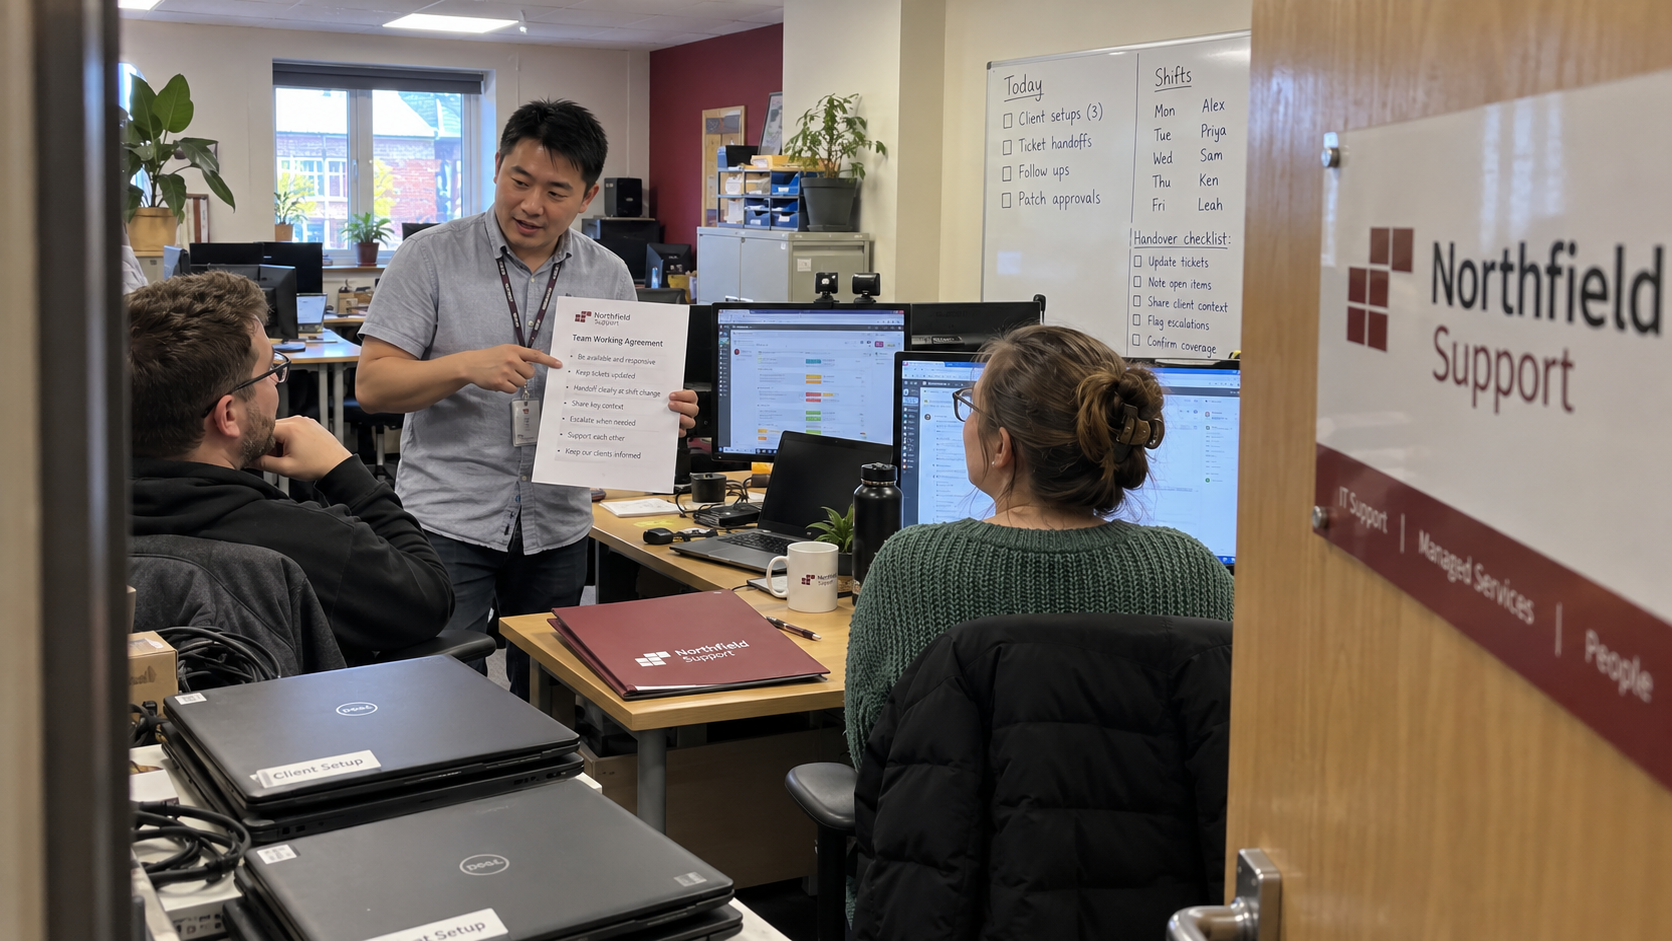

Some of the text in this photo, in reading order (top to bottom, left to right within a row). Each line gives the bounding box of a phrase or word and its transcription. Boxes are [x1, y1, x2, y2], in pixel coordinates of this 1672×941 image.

[1155, 65, 1192, 87] Shifts
[1004, 73, 1044, 102] Today
[1018, 102, 1104, 126] Client setups (3)
[1154, 98, 1225, 118] Mon Alex
[1154, 123, 1227, 143] Tue Priya
[1018, 133, 1093, 152] Ticket handoffs
[1153, 148, 1223, 165] Wed Sam
[1019, 163, 1070, 182] Follow ups
[1152, 173, 1219, 188] Thu Ken
[1018, 189, 1101, 211] Patch approvals
[1152, 198, 1223, 212] Fri Leah
[1134, 230, 1231, 245] Handover checklist:
[1148, 255, 1209, 272] Update tickets
[1148, 277, 1212, 292] Note open items
[1432, 239, 1665, 338] Northfield
[1148, 295, 1229, 313] Share client context
[594, 311, 631, 321] Northfield
[1147, 315, 1210, 331] Flag escalations
[572, 333, 664, 347] Team Working Agreement
[1147, 335, 1217, 359] Confirm coverage
[587, 354, 612, 362] available
[625, 357, 656, 366] responsive
[575, 369, 591, 377] Keep
[1433, 325, 1575, 415] Support
[639, 389, 661, 398] change
[571, 399, 589, 408] Share
[601, 402, 624, 410] context
[569, 415, 595, 424] Escalate
[613, 419, 636, 427] needed
[567, 431, 625, 442] Support each other
[565, 447, 581, 456] Keep
[593, 449, 613, 458] clients
[614, 450, 642, 460] informed
[1339, 486, 1654, 703] IT Support Managed Services People
[675, 640, 750, 656] Northfield
[682, 650, 736, 663] Support
[273, 757, 364, 781] Client Setup
[434, 922, 486, 941] Setup
